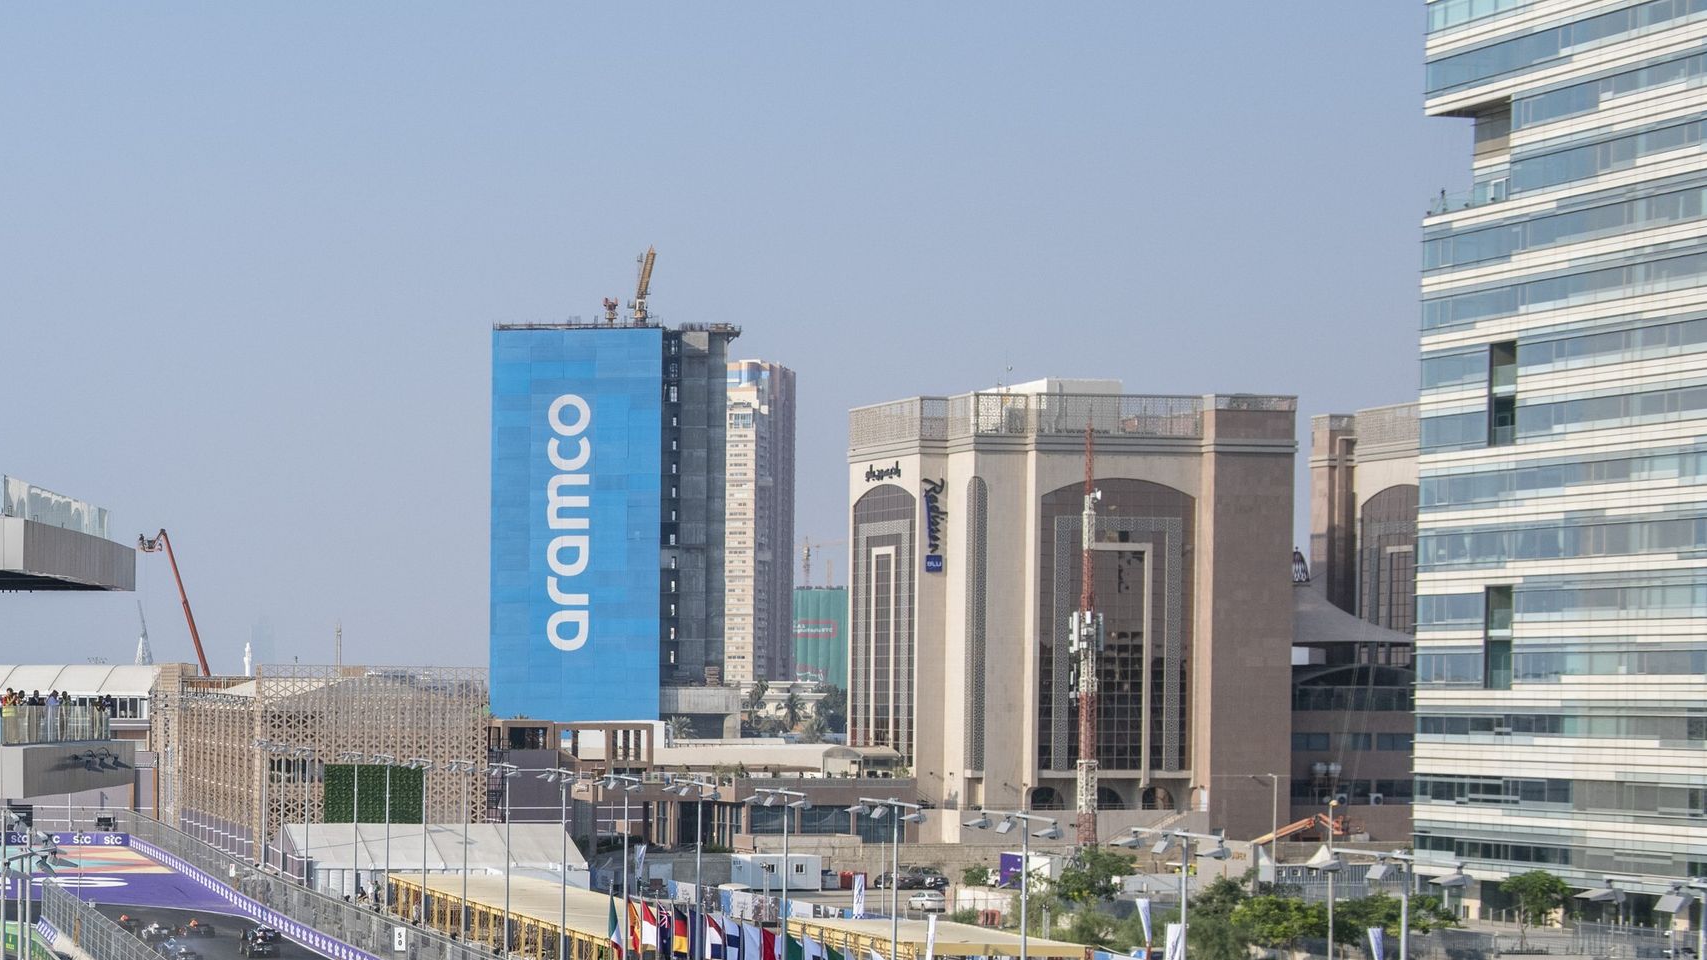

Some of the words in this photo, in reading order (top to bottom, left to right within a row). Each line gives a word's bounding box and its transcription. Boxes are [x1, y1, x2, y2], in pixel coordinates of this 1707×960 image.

[547, 394, 591, 651] aramco
[922, 478, 948, 553] Radisson
[73, 834, 91, 844] stc
[103, 834, 122, 844] stc
